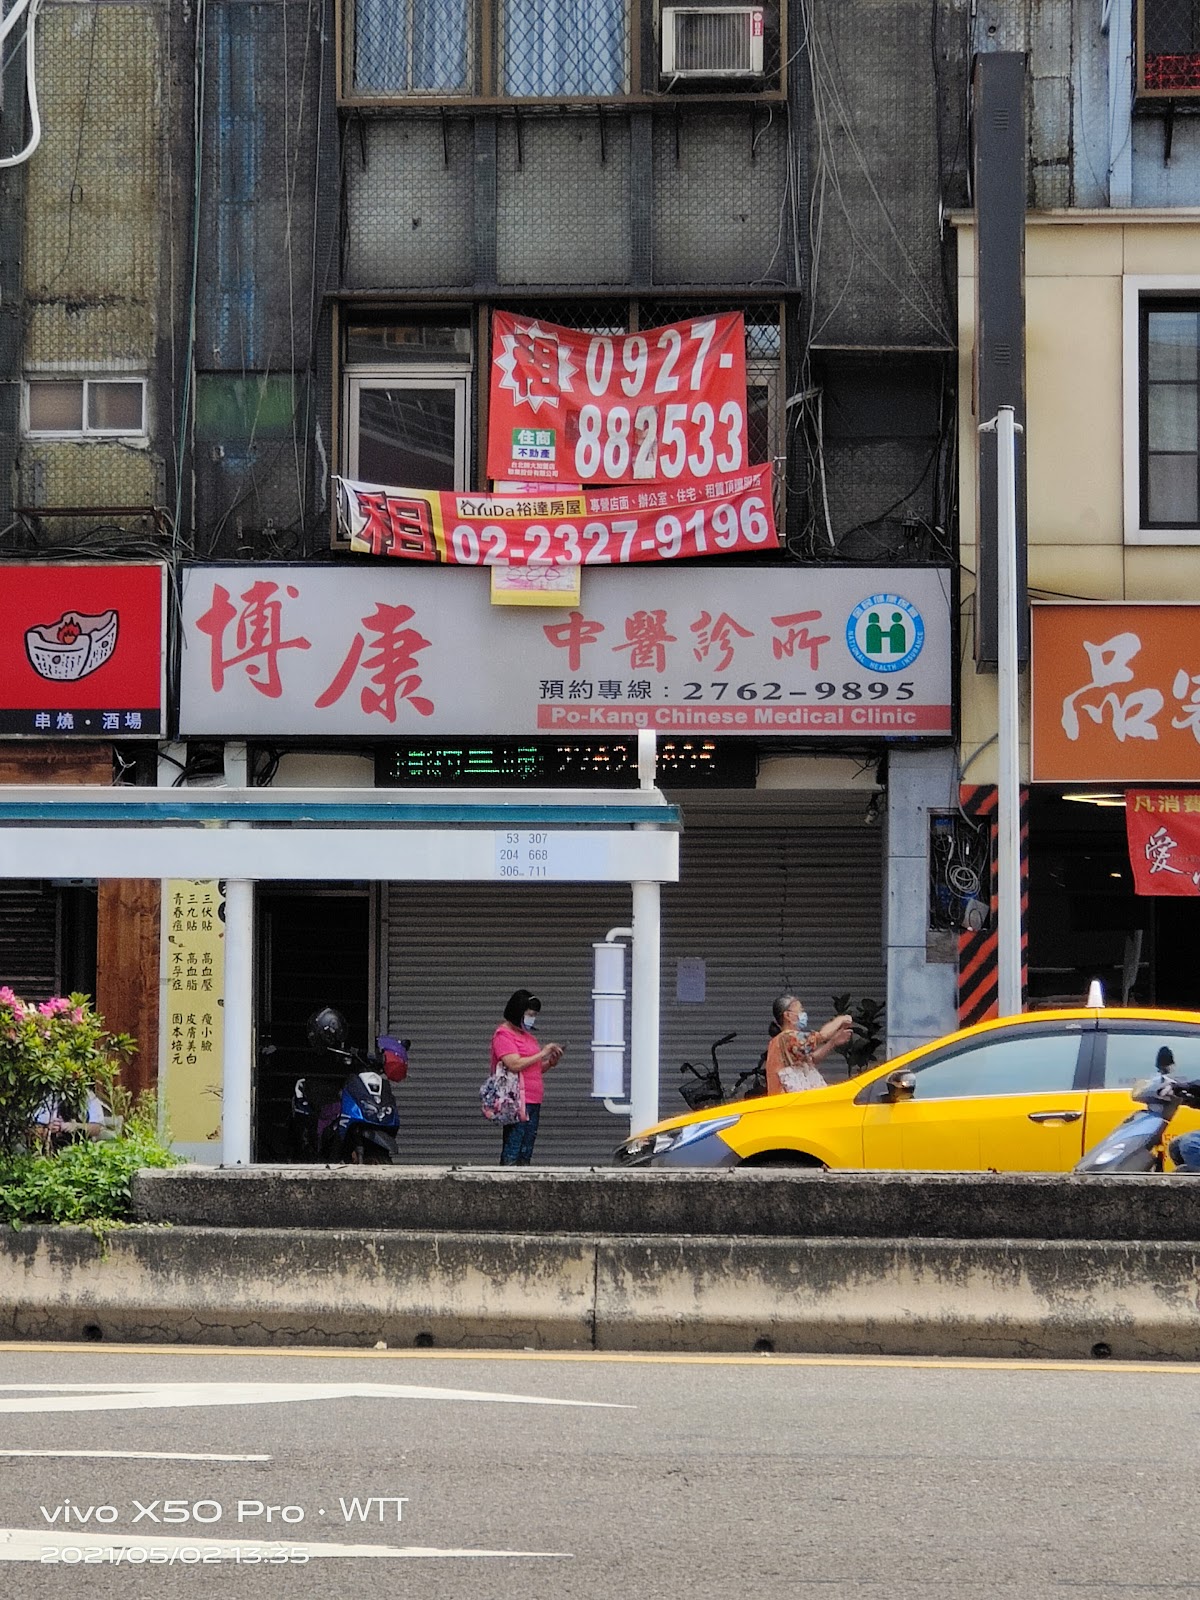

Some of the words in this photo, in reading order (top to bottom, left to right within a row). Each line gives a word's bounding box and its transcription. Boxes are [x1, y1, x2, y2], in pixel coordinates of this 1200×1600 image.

[513, 333, 561, 398] 租
[518, 429, 551, 446] 住商
[518, 448, 550, 459] 不動產
[575, 401, 743, 479] 882533
[354, 491, 441, 562] 租
[452, 497, 769, 566] 02-2327-9196
[196, 581, 435, 724] 博康
[543, 609, 831, 673] 中醫診所
[869, 661, 897, 671] HEALTH
[683, 681, 915, 701] 2762-9895
[551, 707, 649, 727] Po-Kang
[655, 706, 748, 724] Chinese
[754, 706, 844, 724] Medical
[851, 706, 917, 724] Clinic
[500, 849, 519, 860] 204
[528, 849, 548, 860] 668
[506, 833, 519, 844] 53
[528, 833, 548, 844] 307
[500, 865, 519, 876] 306
[528, 866, 547, 876] 711
[186, 894, 198, 931] 三九貼
[201, 894, 213, 931] 三伏貼
[172, 952, 183, 990] 不孕症
[186, 952, 198, 991] 高血脂
[201, 952, 213, 992] 高血壓
[171, 1013, 183, 1065] 固本培元
[186, 1013, 197, 1065] 皮膚美白
[201, 1013, 213, 1052] 瘦小臉
